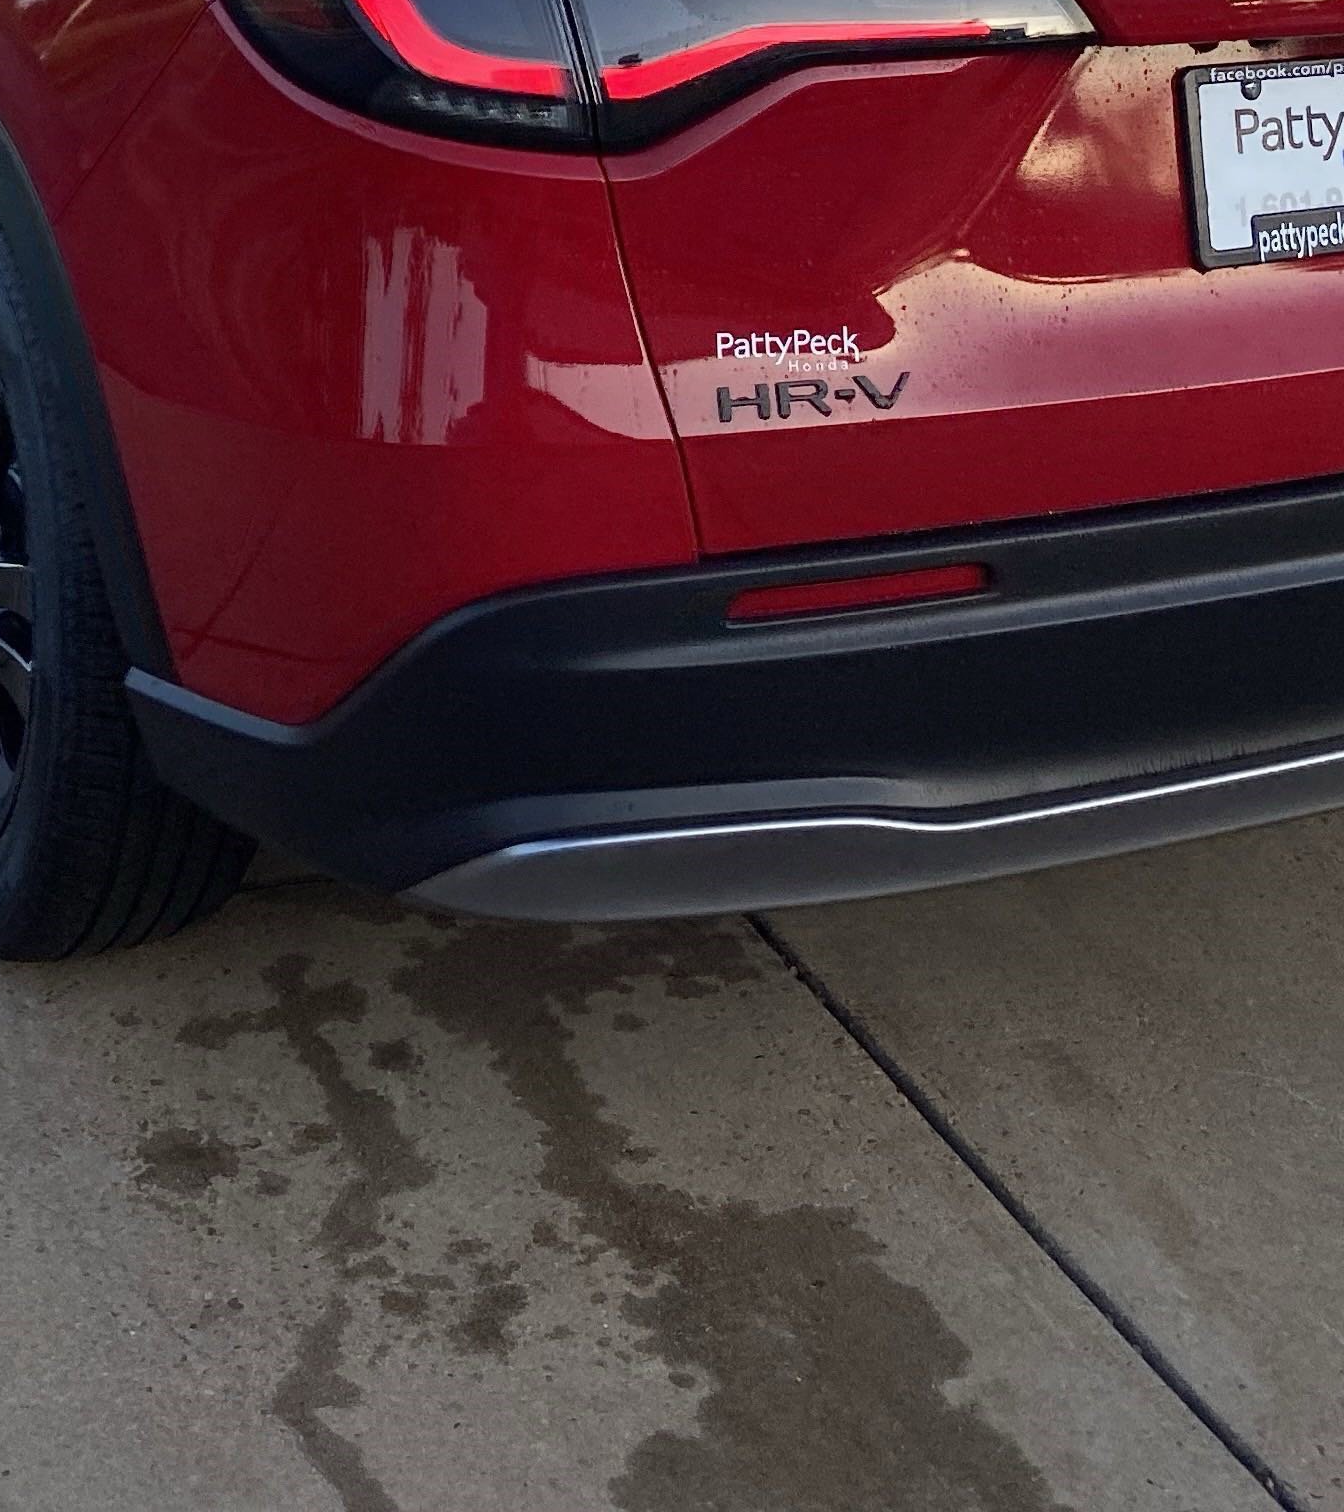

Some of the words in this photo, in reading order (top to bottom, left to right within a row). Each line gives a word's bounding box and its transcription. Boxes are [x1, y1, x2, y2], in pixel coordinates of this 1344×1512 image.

[716, 325, 860, 365] PattyPeck
[788, 359, 849, 373] Honda
[716, 371, 911, 423] HR-V
